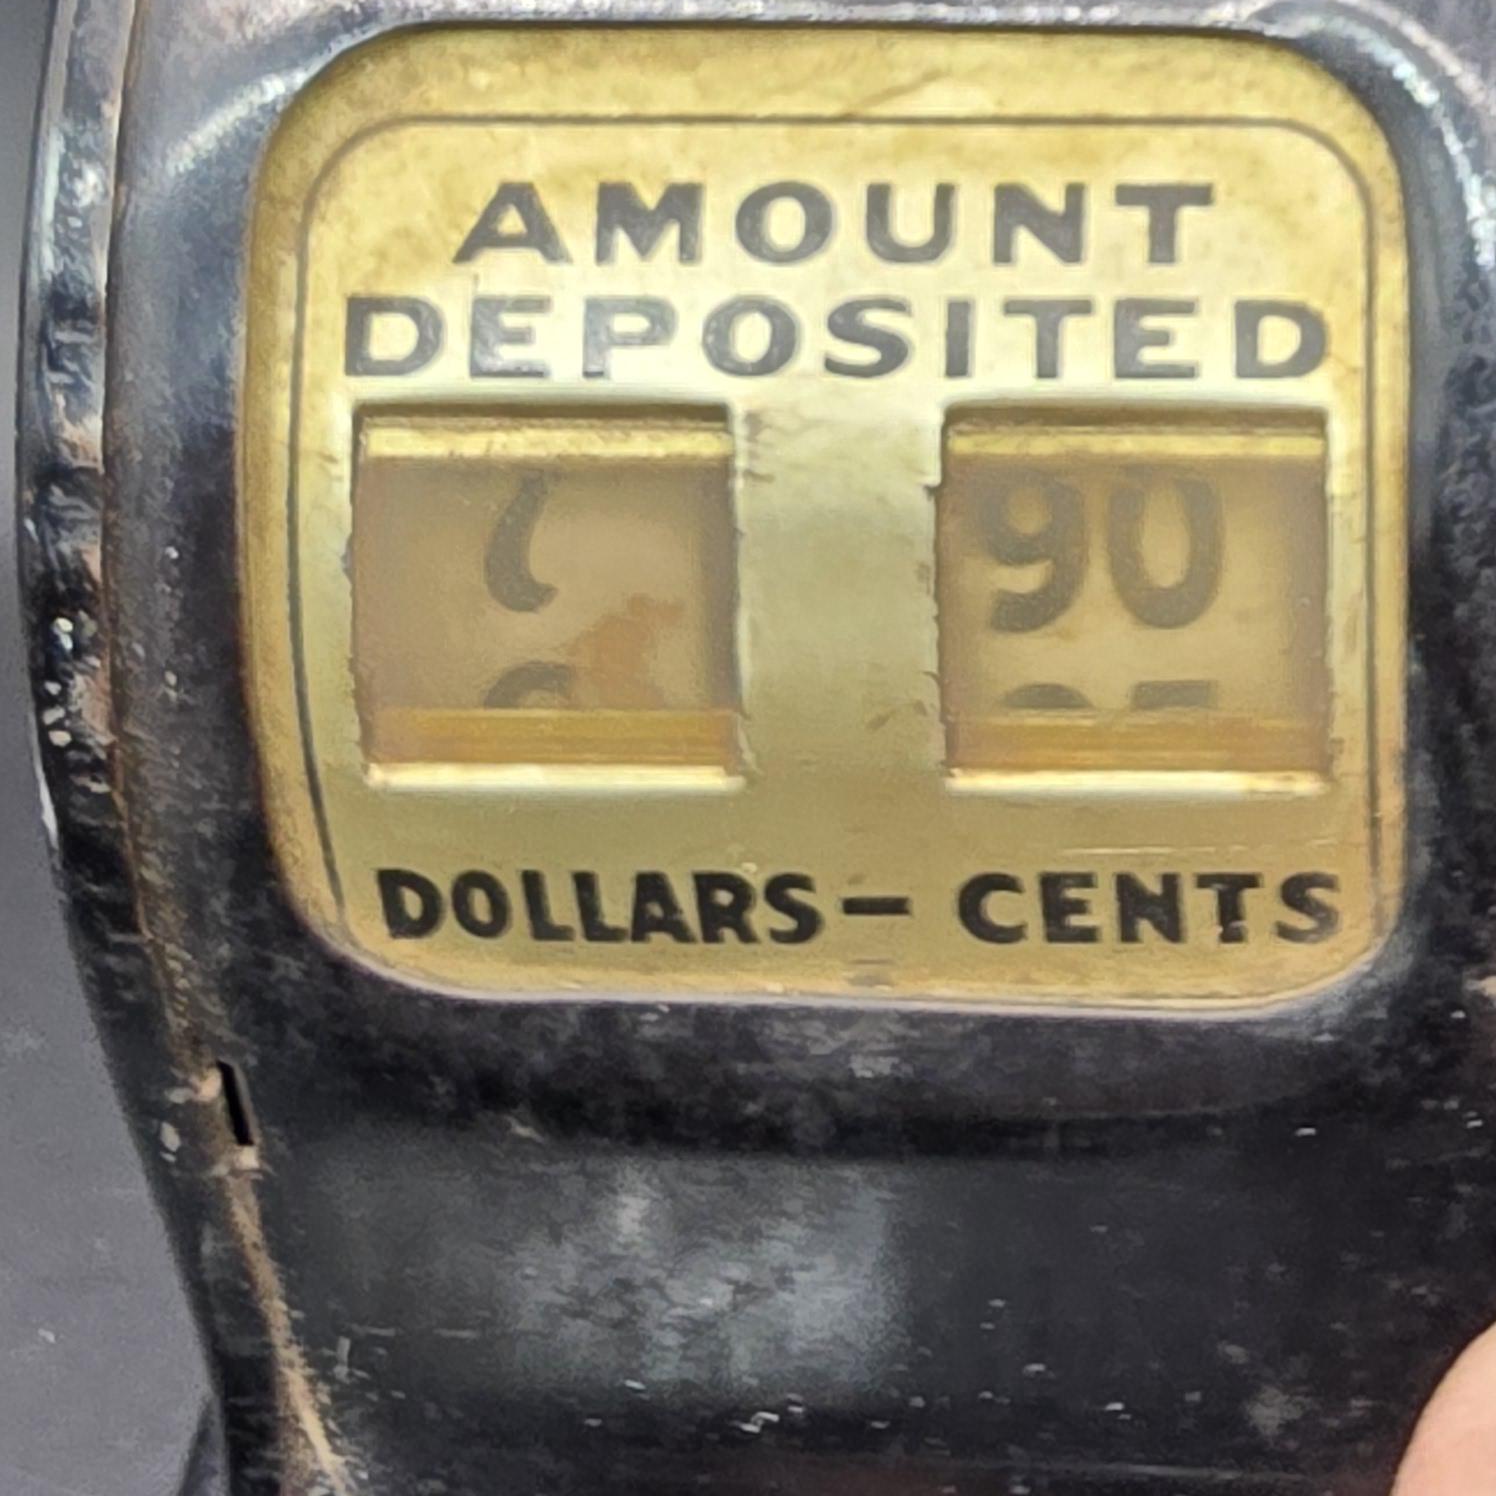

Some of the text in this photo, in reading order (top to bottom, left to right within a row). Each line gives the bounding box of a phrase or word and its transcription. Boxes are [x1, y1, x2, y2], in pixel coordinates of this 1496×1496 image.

[453, 181, 1215, 265] AMOUNT
[344, 295, 1328, 380] DEPOSITED
[977, 466, 1226, 633] 90
[956, 872, 1342, 944] CENTS
